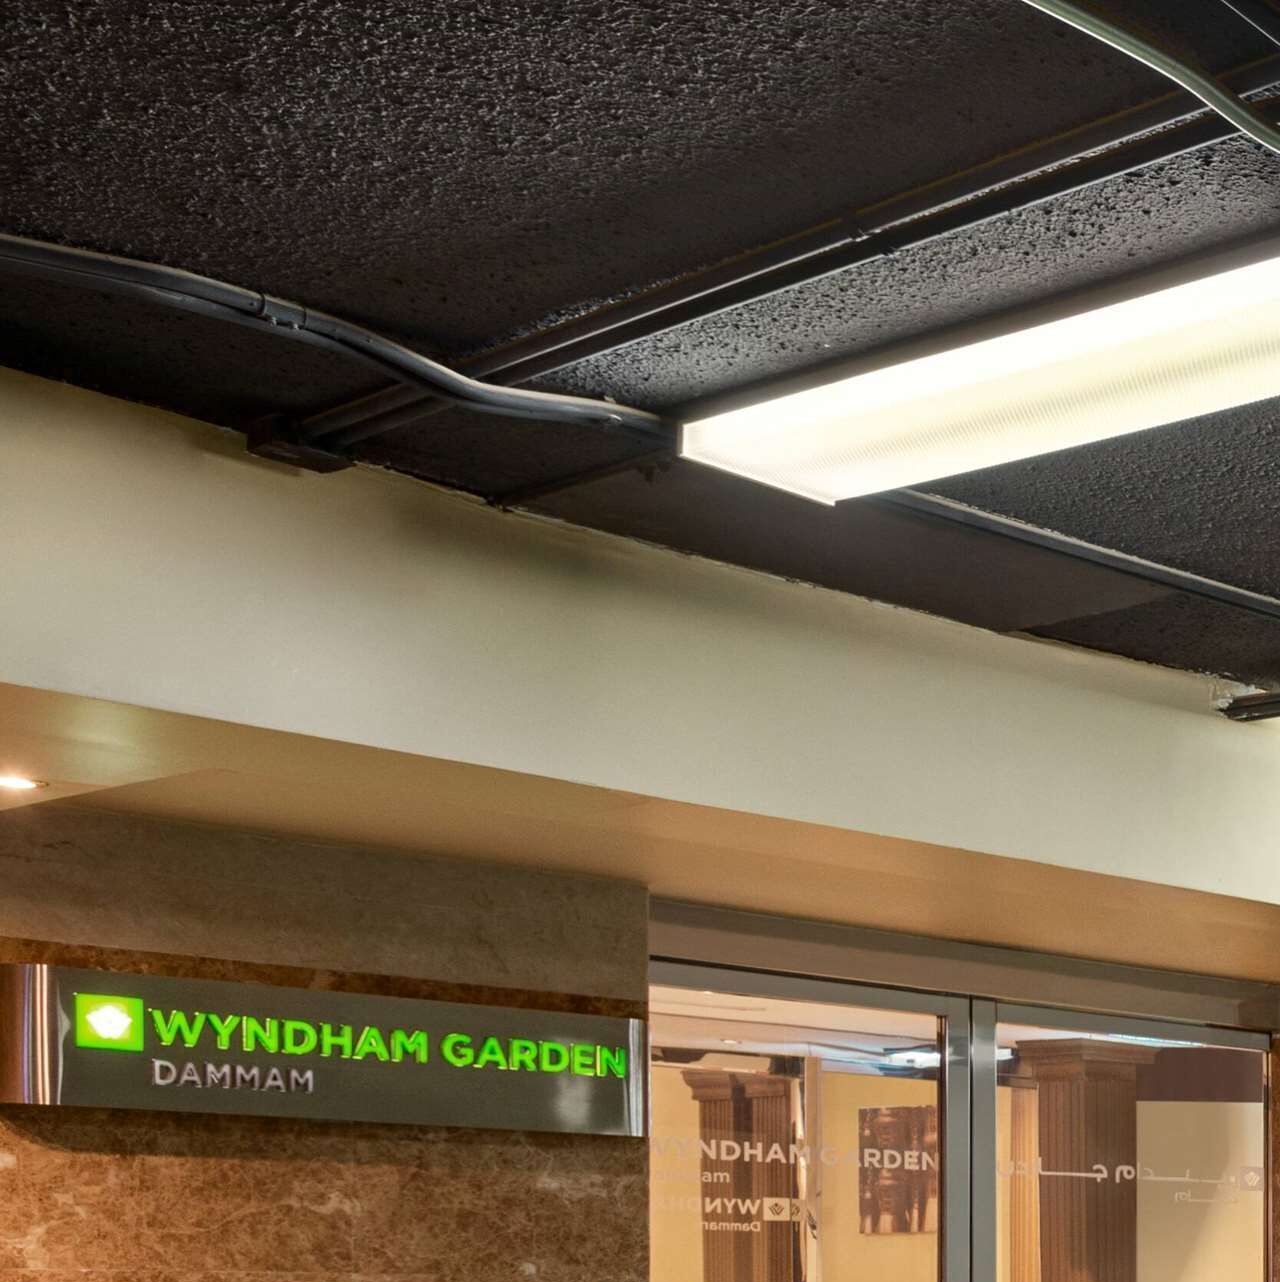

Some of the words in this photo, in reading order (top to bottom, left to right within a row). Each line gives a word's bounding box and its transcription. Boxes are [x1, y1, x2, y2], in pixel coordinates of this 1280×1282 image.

[148, 1008, 428, 1064] WYNDHAM
[441, 1032, 627, 1078] GARDEN
[152, 1058, 315, 1094] DAMMAM
